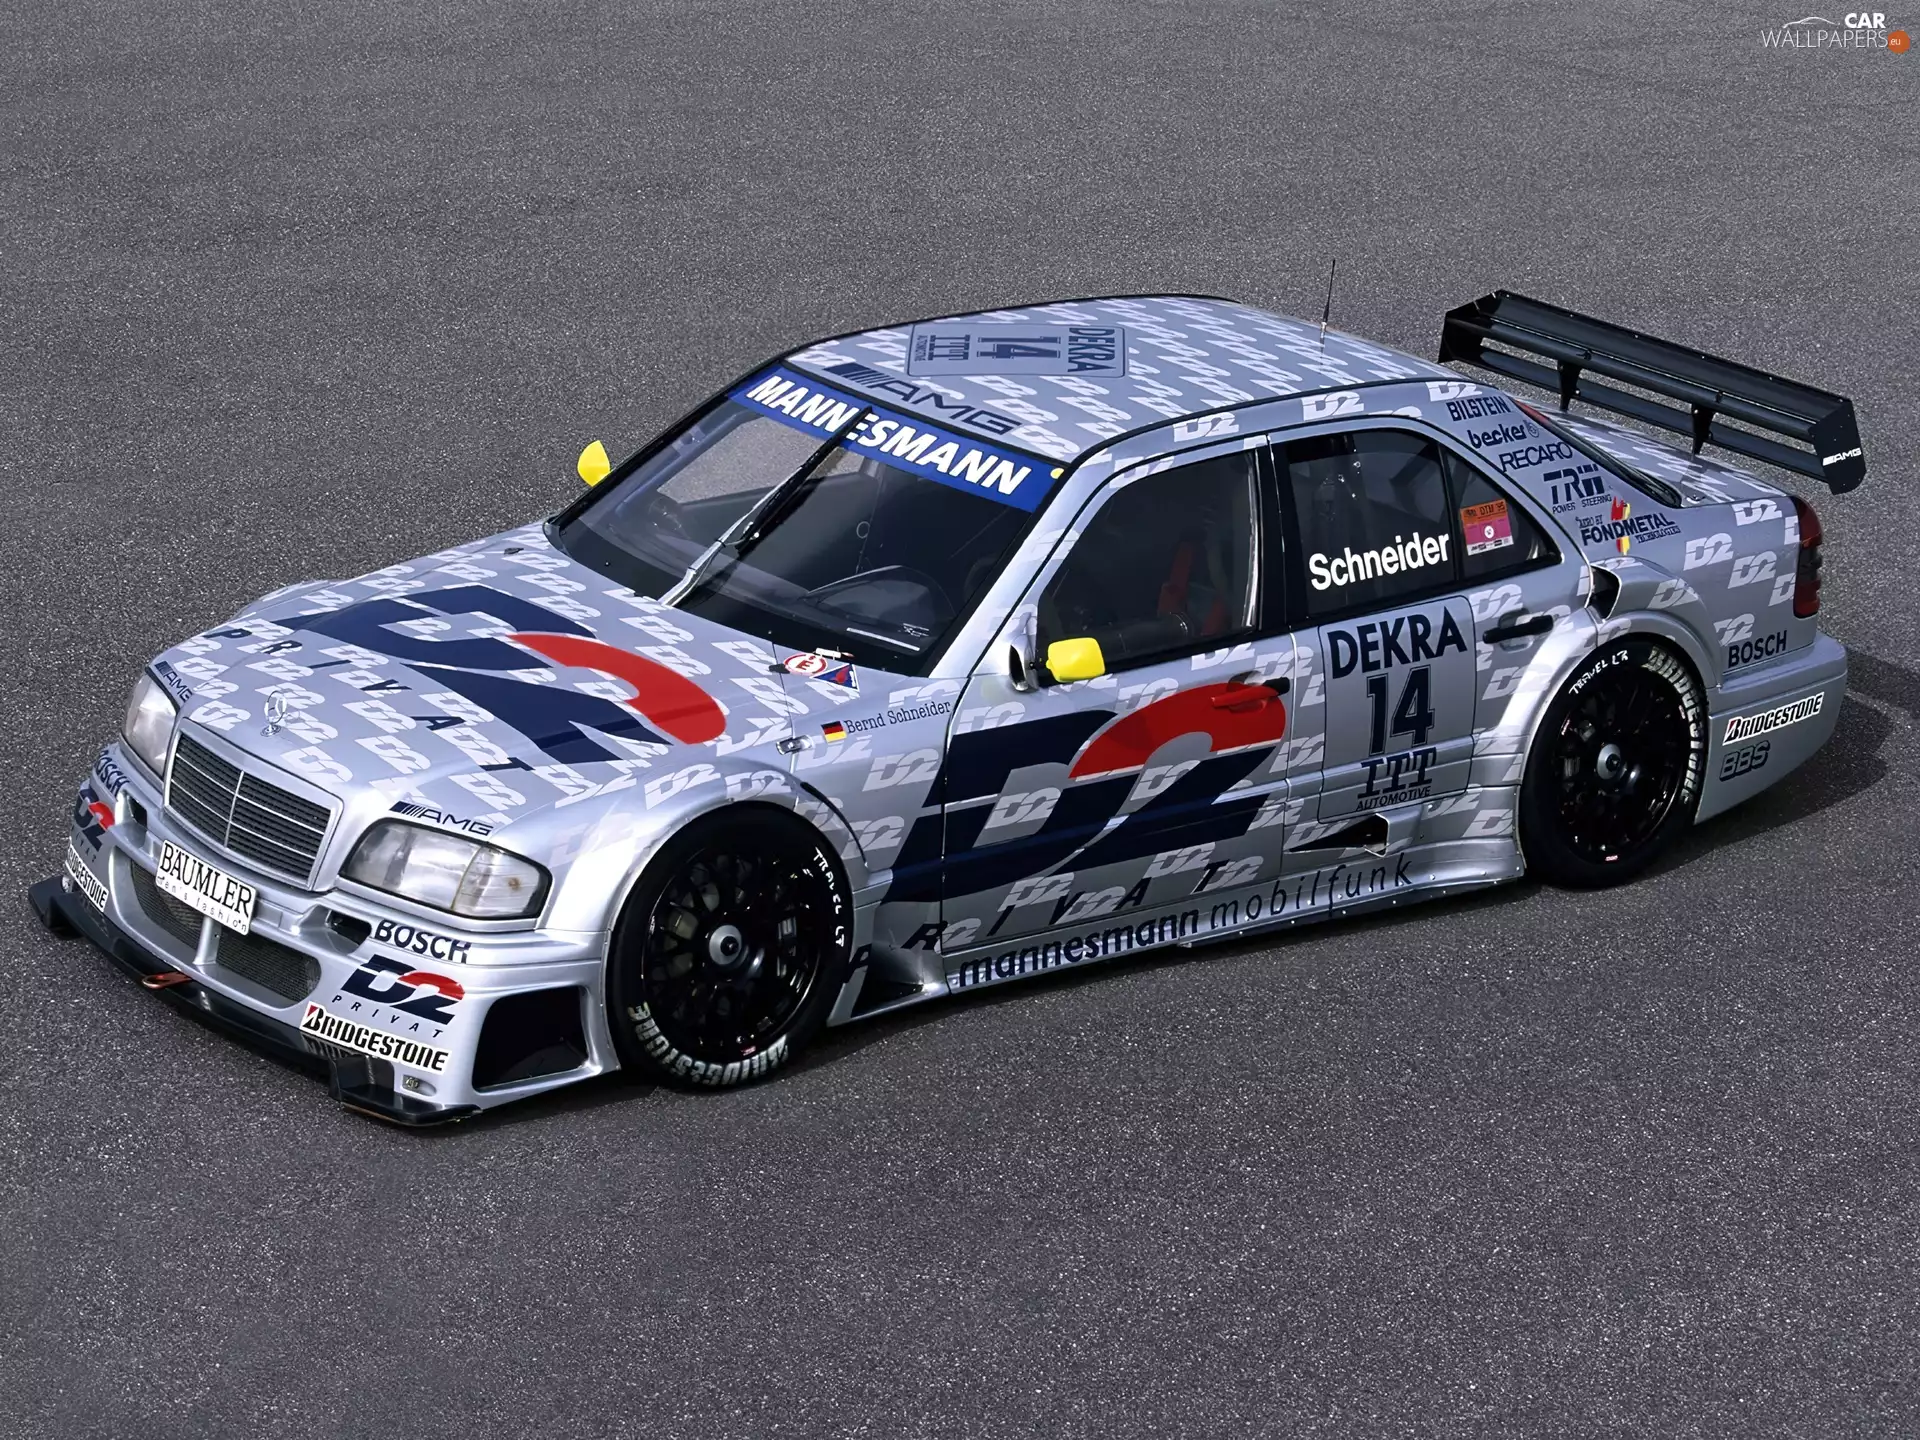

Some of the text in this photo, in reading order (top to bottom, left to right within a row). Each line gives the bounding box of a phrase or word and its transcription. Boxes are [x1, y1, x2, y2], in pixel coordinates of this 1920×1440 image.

[977, 336, 1061, 359] 14
[1067, 328, 1116, 372] DEKRA
[870, 380, 1022, 435] AMG
[1301, 391, 1365, 421] D2
[1425, 381, 1484, 402] D2
[1445, 396, 1512, 421] BILSTEIN
[746, 375, 1033, 496] MANNESMANN
[1172, 412, 1239, 442] D2
[1467, 424, 1527, 449] becker
[1498, 441, 1573, 473] RECARO
[1833, 448, 1862, 463] AMG
[1552, 494, 1612, 514] POWER STEERING
[1732, 499, 1782, 526] D2
[1580, 512, 1676, 547] FONDMETAL
[1309, 532, 1450, 590] Schneider
[1683, 533, 1734, 571] D2
[1728, 551, 1777, 589] D2
[1327, 606, 1468, 679] DEKRA
[1728, 630, 1787, 668] BOSCH
[163, 668, 193, 702] AMG
[844, 701, 950, 733] Bernd Schneider
[1366, 665, 1436, 756] 14
[1725, 696, 1823, 743] BRIDGESTONE
[862, 749, 939, 791] D2
[1357, 747, 1436, 800] ITT
[1719, 740, 1770, 782] BBS
[984, 787, 1061, 829] D2
[1355, 786, 1431, 812] AUTOMOTIVE
[419, 808, 494, 836] AMG
[160, 842, 252, 918] BÄUMLER
[960, 852, 1413, 986] mannesmann mobilfunk
[375, 920, 471, 964] BOSCH
[341, 954, 466, 1025] D2
[332, 994, 443, 1038] PRIVAT
[303, 1007, 449, 1072] BRIDGESTONE
